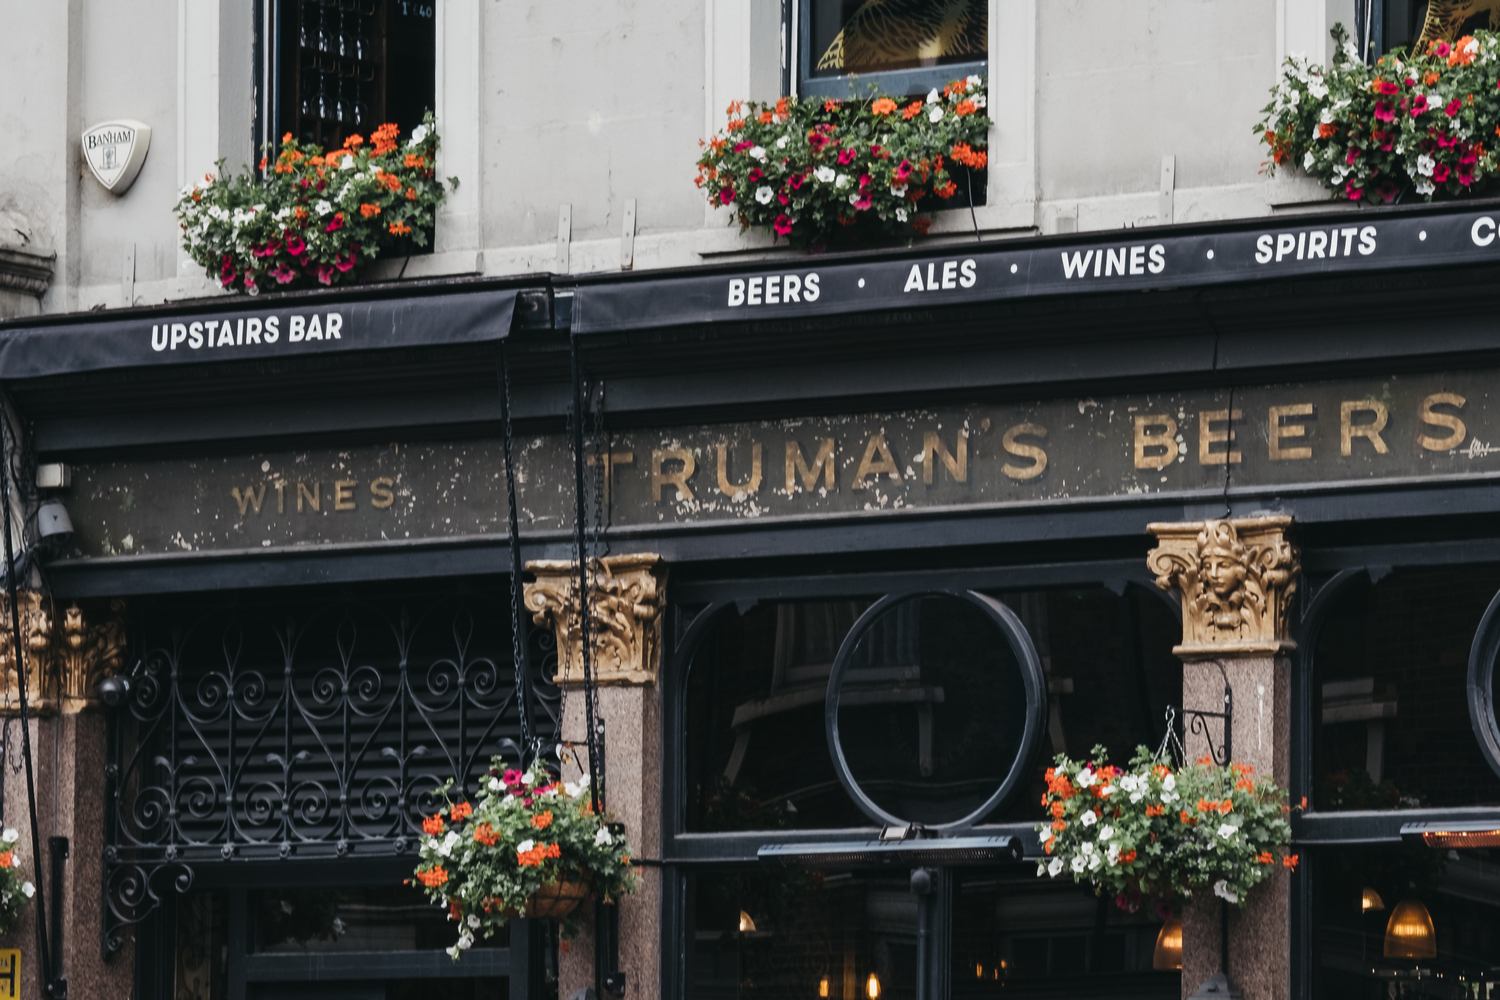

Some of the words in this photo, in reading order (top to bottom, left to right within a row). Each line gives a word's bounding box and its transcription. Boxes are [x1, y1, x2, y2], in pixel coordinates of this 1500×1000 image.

[88, 130, 131, 149] BANHAM
[727, 273, 820, 306] BEERS
[904, 259, 977, 292] ALES
[1061, 244, 1166, 279] WINES
[1255, 226, 1377, 264] SPIRITS
[151, 316, 280, 352] UPSTAIRS
[289, 312, 343, 343] BAR
[1133, 393, 1467, 469] BEERS
[231, 477, 394, 516] WINES
